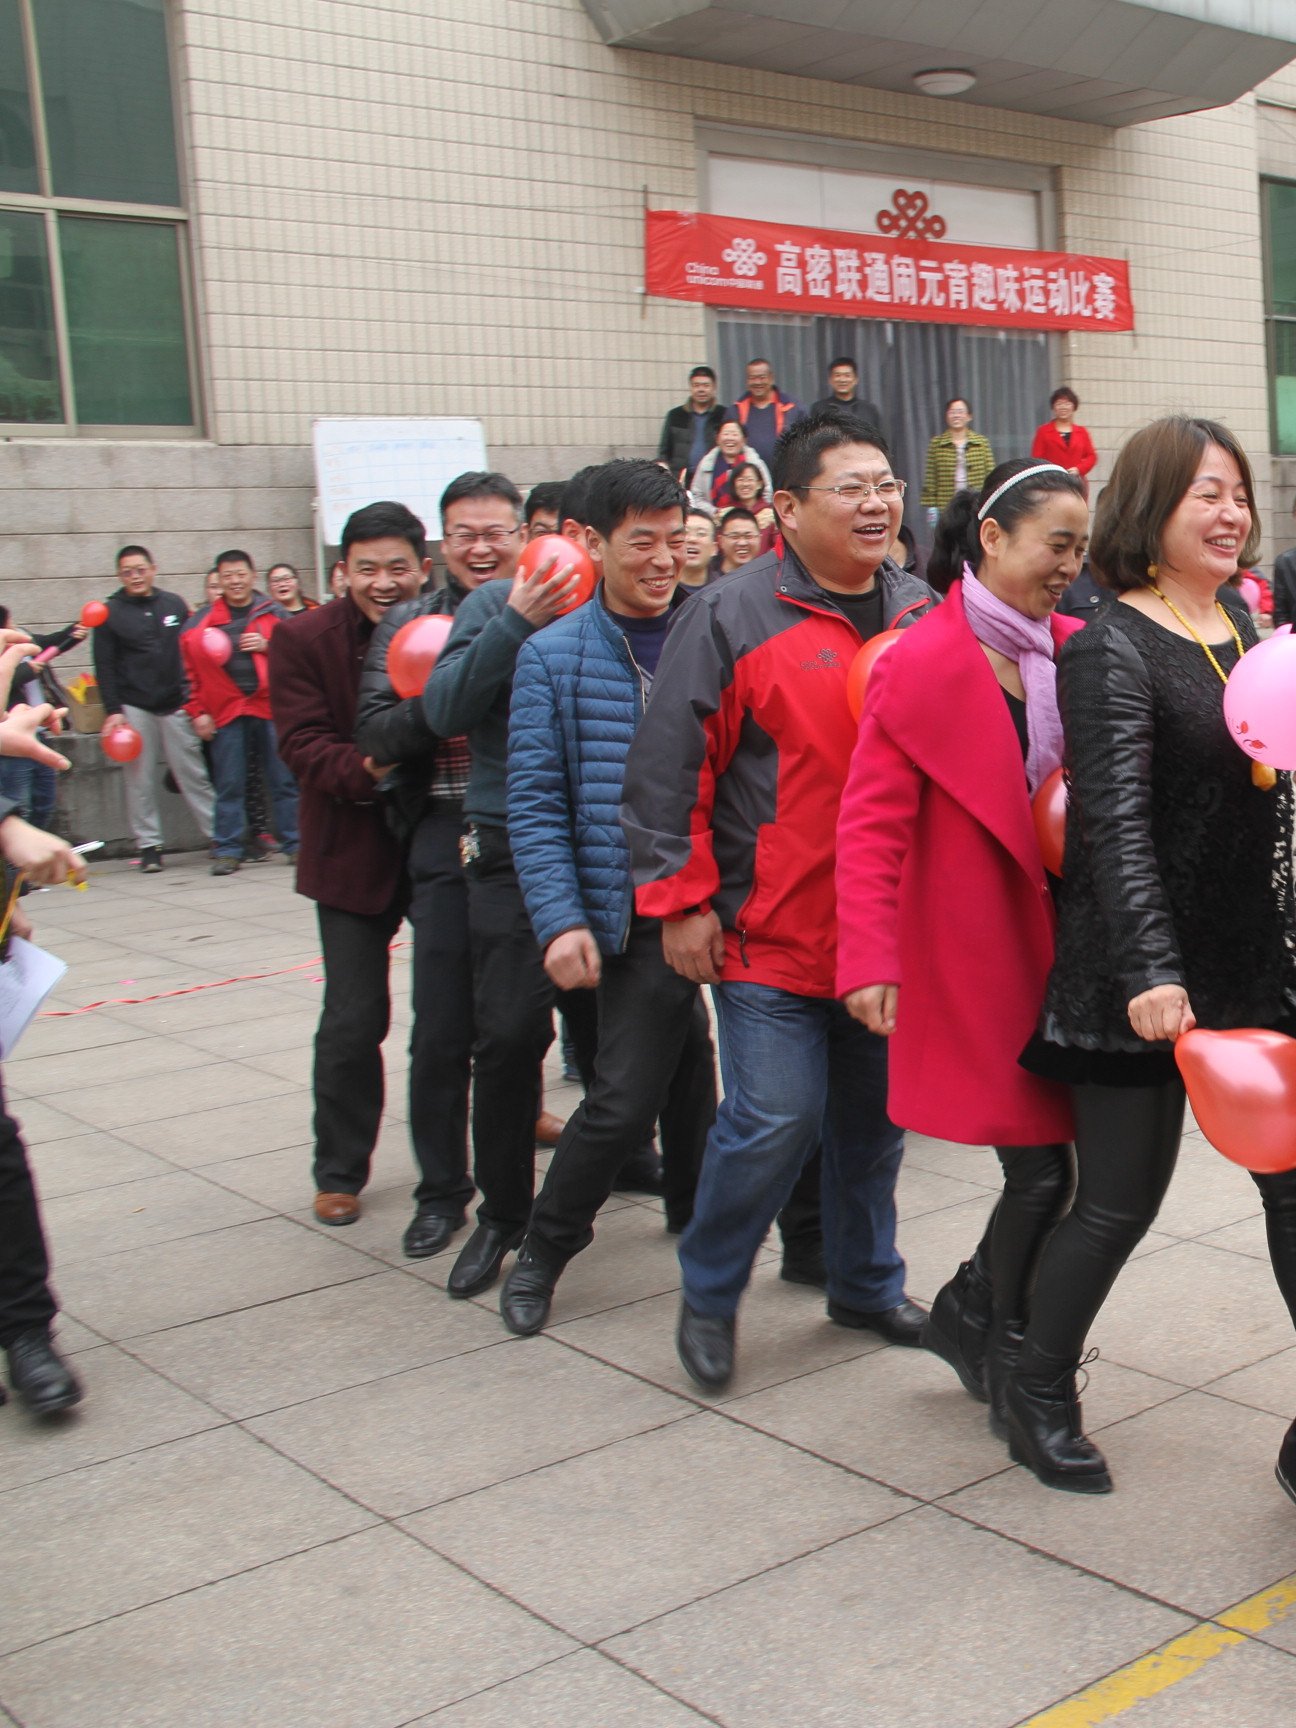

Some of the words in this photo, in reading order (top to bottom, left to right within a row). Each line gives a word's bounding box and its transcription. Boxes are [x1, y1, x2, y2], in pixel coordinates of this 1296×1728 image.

[685, 262, 720, 275] China
[774, 240, 1116, 320] 高密联通闹元宵趣味运动比赛
